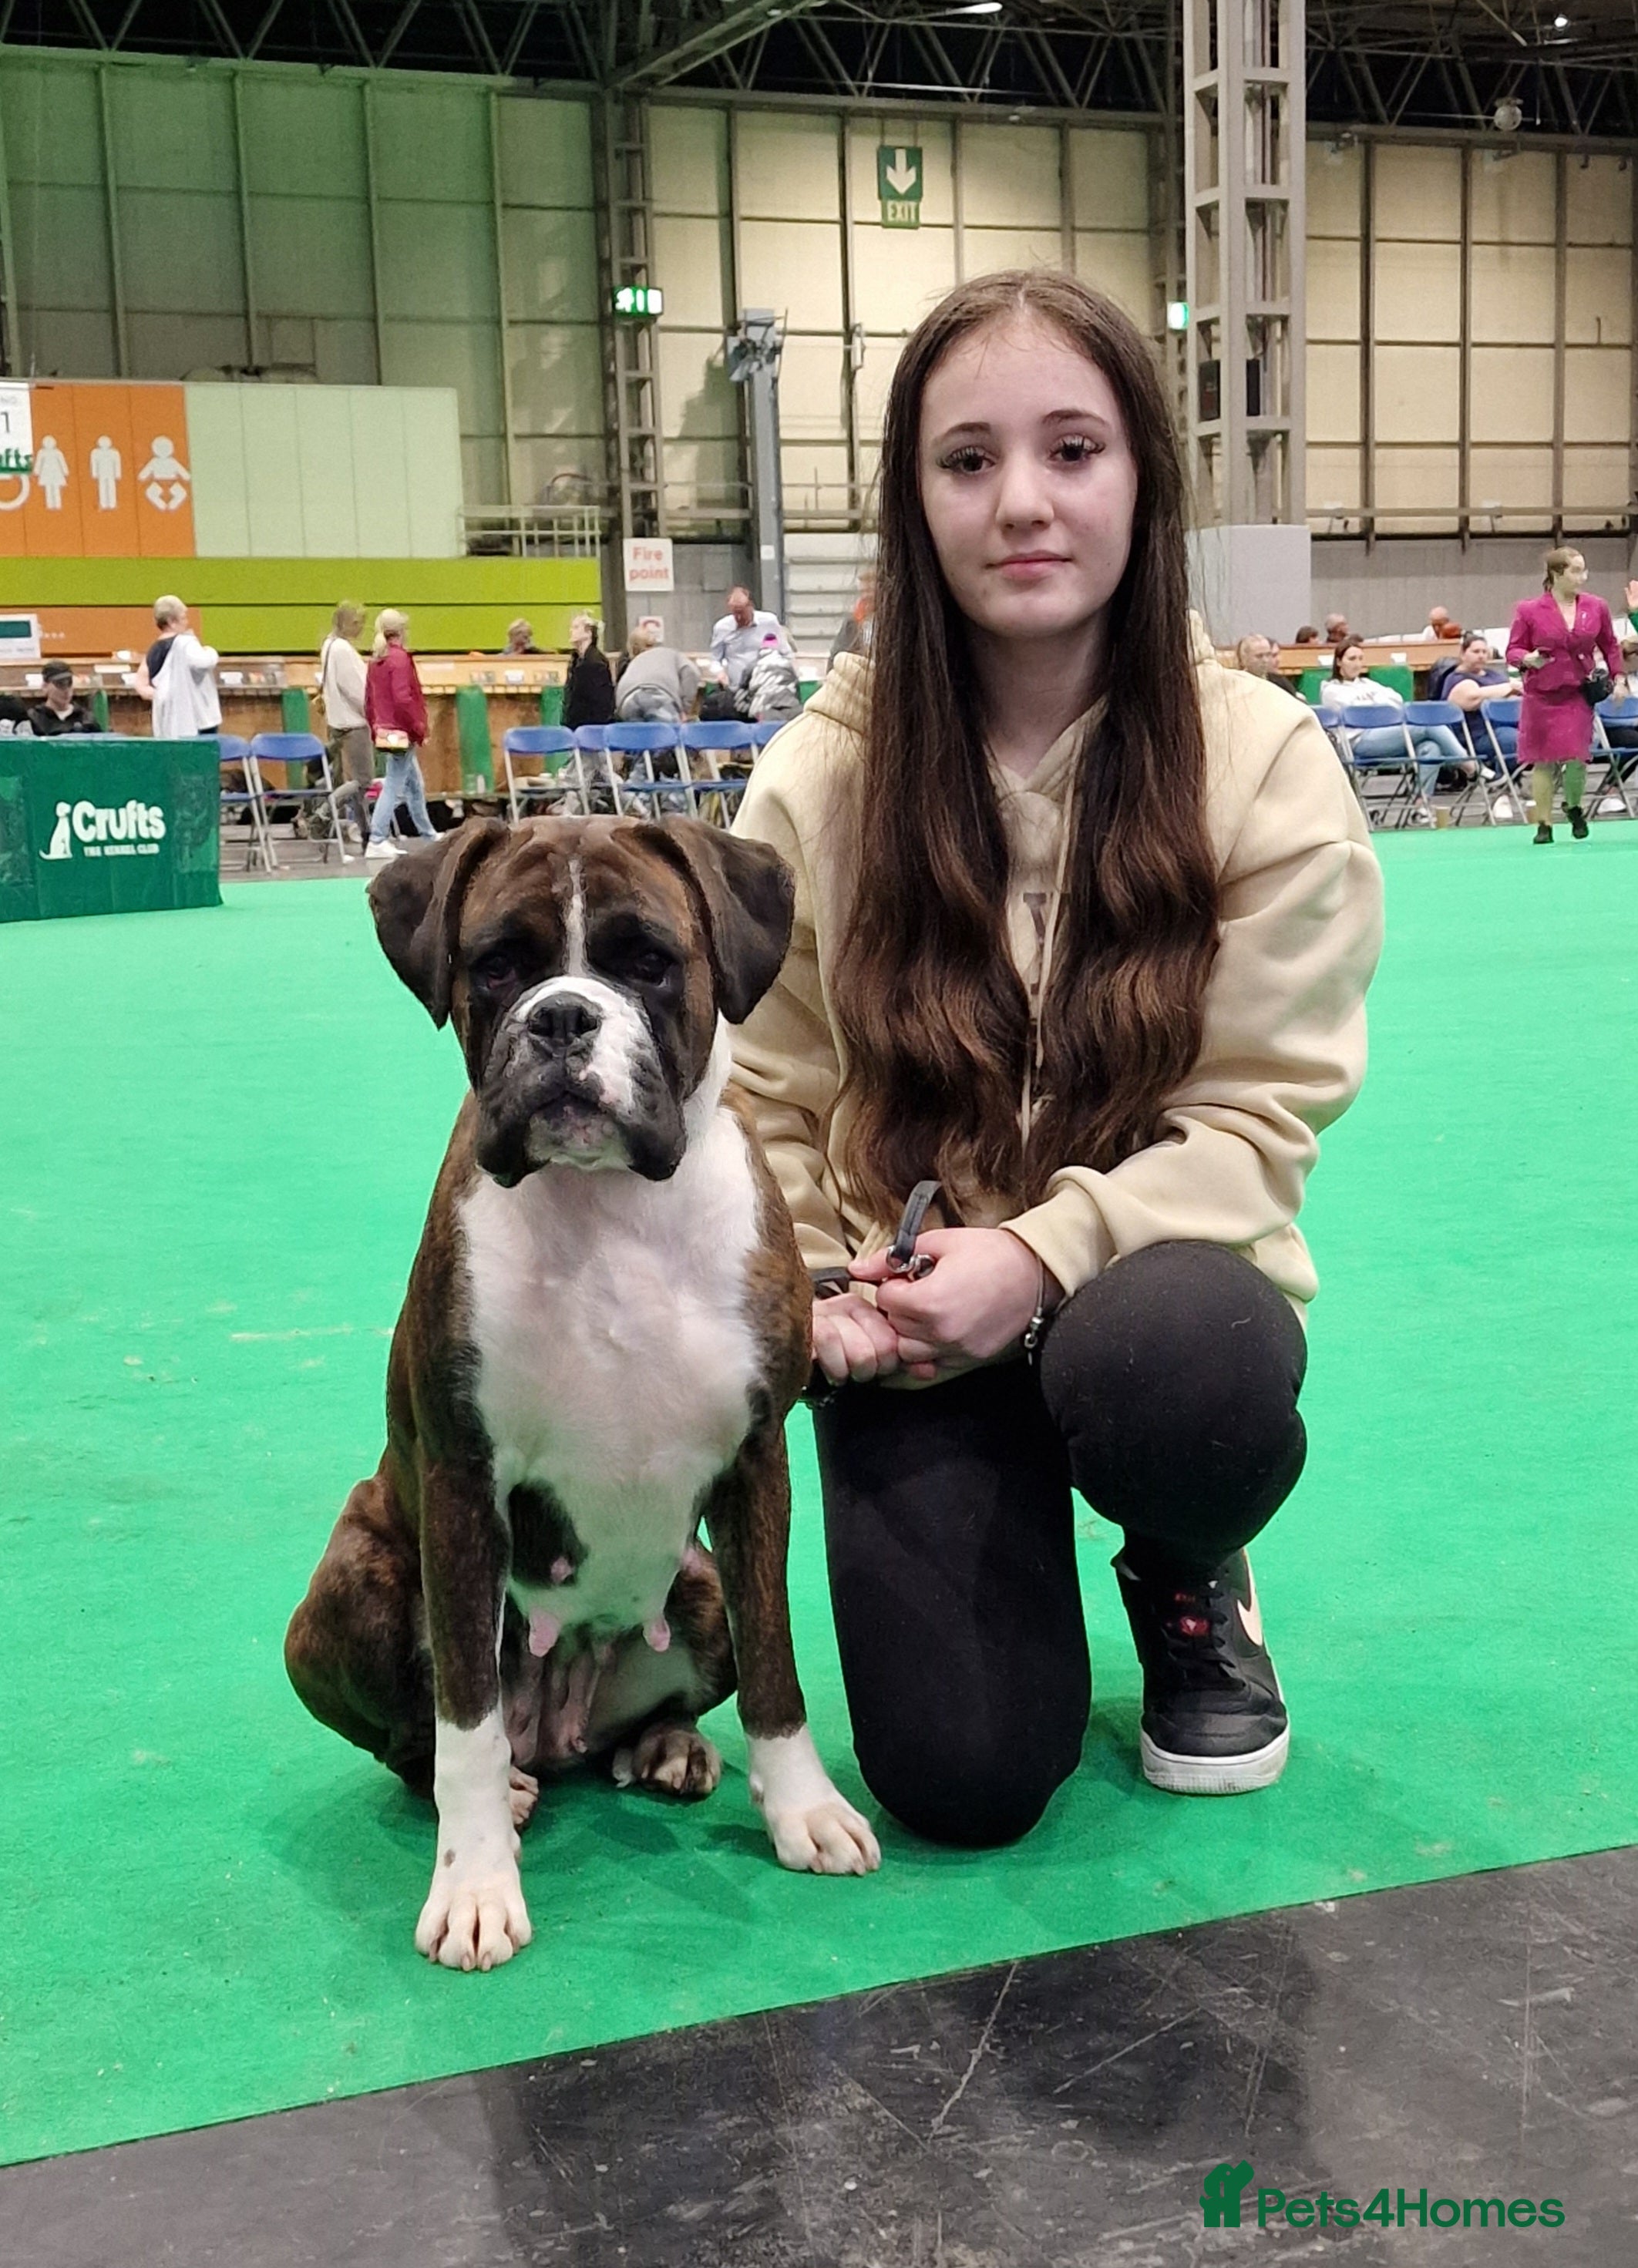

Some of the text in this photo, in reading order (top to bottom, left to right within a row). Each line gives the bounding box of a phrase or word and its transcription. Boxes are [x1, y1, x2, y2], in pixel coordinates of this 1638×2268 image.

[886, 200, 916, 222] EXIT
[633, 546, 663, 561] Fire
[629, 565, 669, 582] point
[72, 799, 166, 842] Crufts
